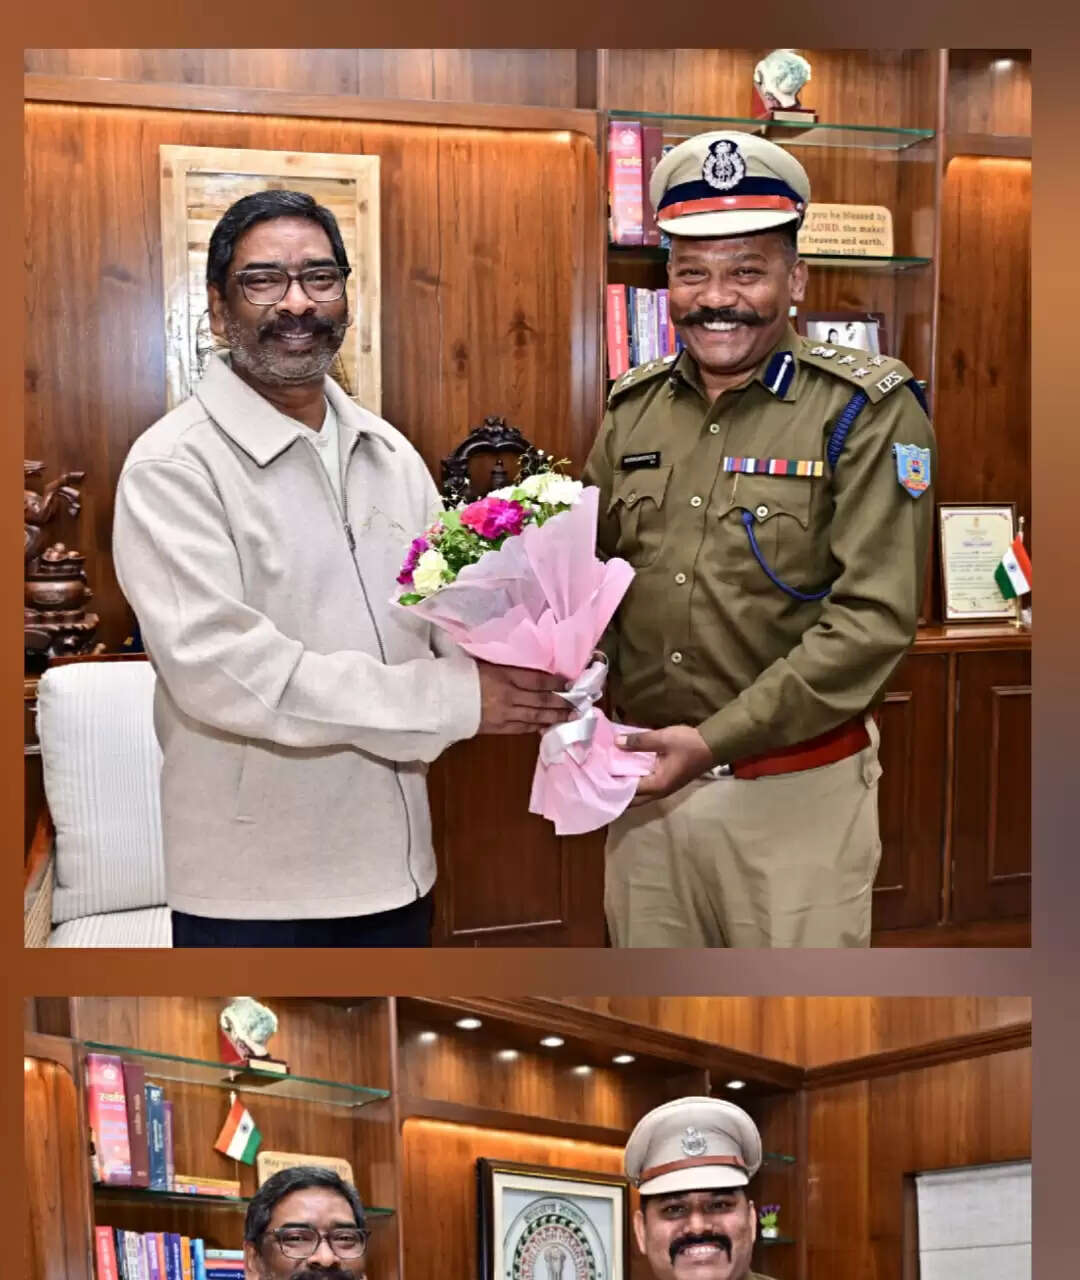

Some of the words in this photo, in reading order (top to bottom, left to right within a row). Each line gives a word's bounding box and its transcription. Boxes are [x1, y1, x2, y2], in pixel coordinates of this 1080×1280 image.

[808, 235, 838, 245] heaven
[841, 236, 857, 245] and
[876, 370, 904, 393] IPS
